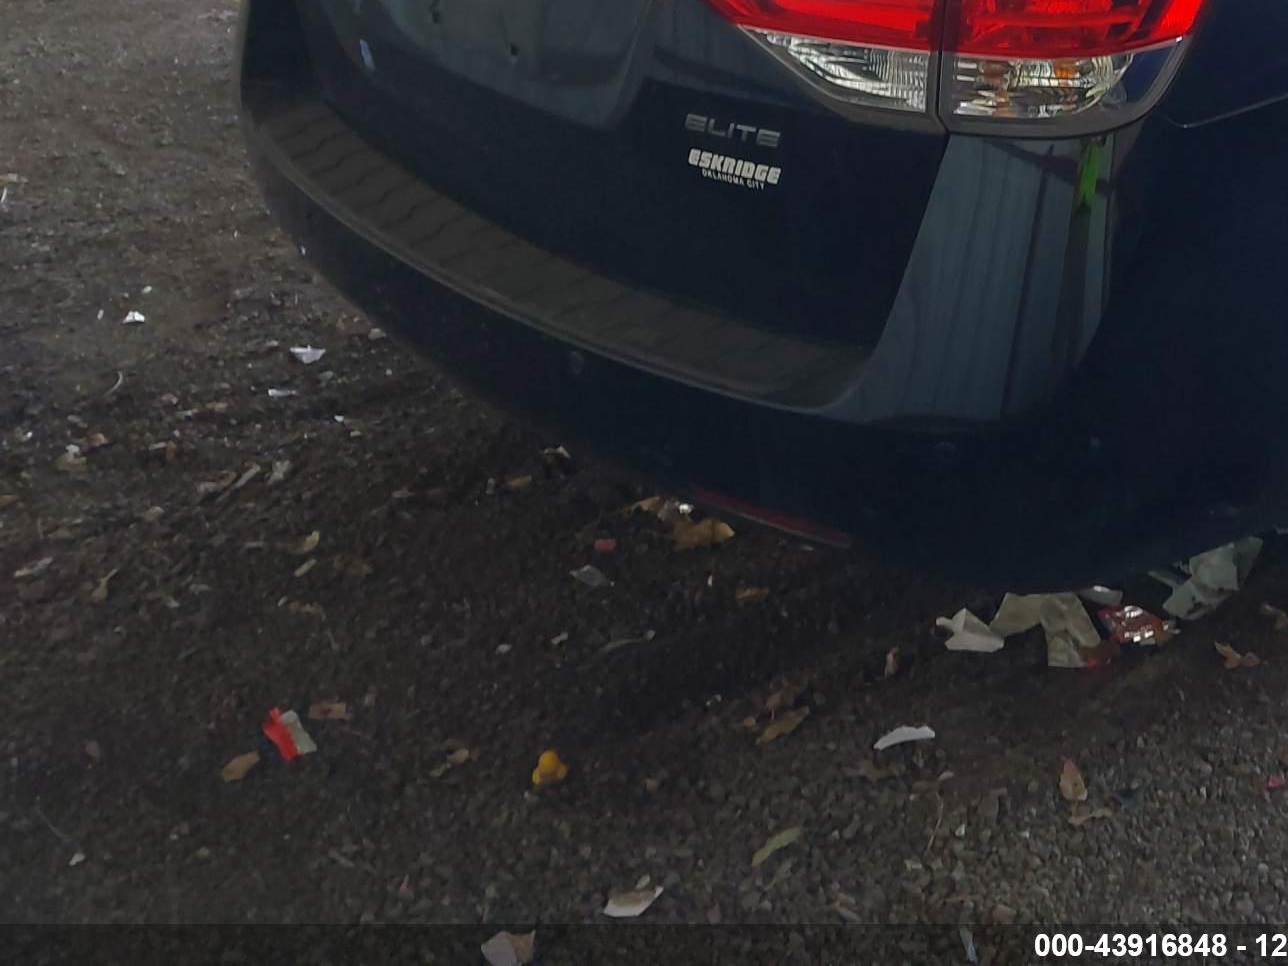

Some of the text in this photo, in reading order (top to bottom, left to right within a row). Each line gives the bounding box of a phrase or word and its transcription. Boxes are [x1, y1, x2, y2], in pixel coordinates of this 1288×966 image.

[685, 114, 780, 147] ELITE
[688, 148, 782, 185] ESKRIDGE
[702, 168, 765, 191] OKLAHOMA CITY
